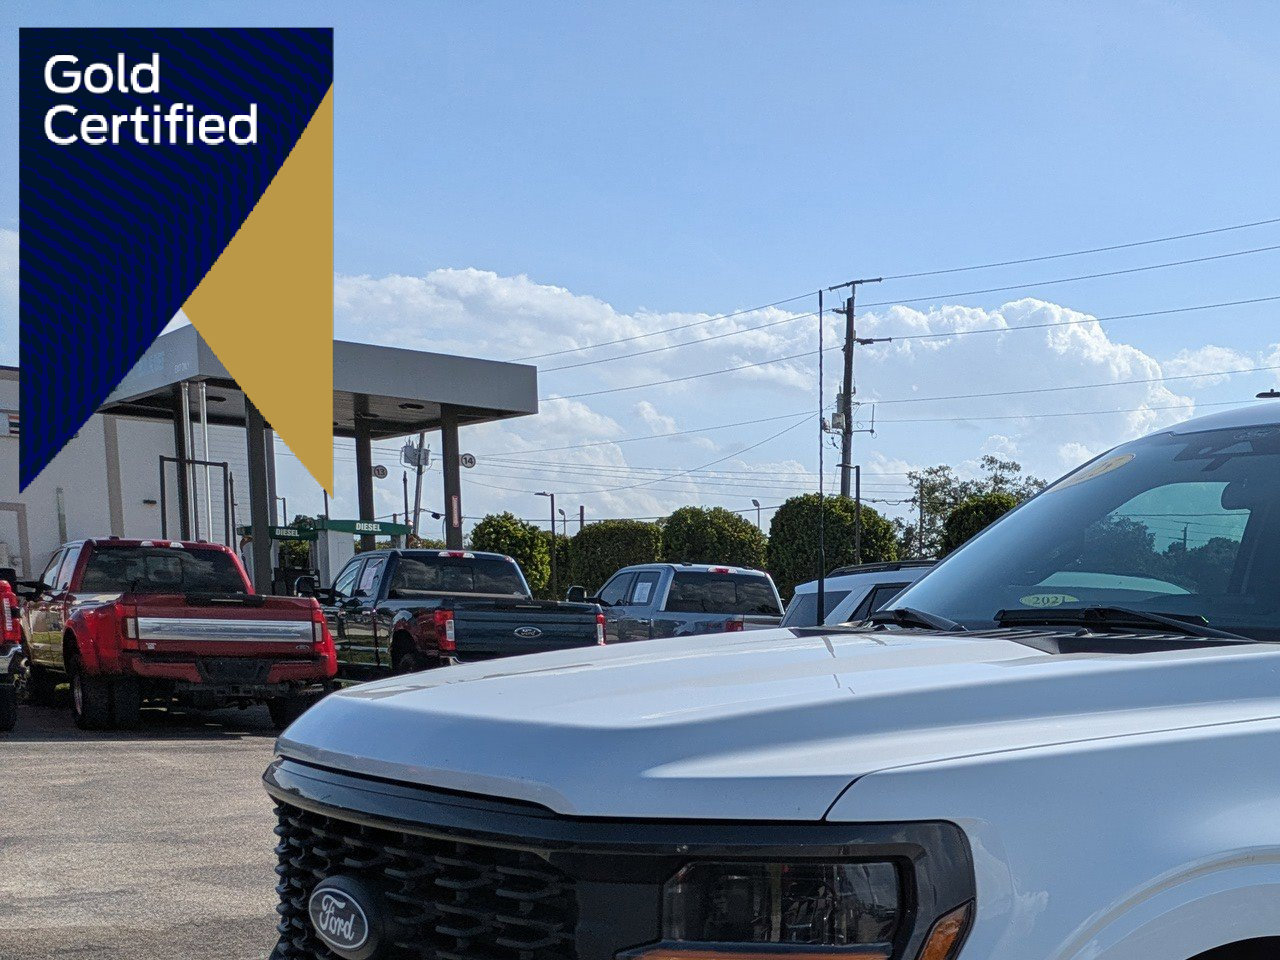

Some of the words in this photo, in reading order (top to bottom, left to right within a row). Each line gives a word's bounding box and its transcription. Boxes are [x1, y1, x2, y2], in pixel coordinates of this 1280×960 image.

[356, 522, 382, 532] DIESEL
[275, 528, 300, 537] DIESEL
[319, 894, 356, 941] Ford
